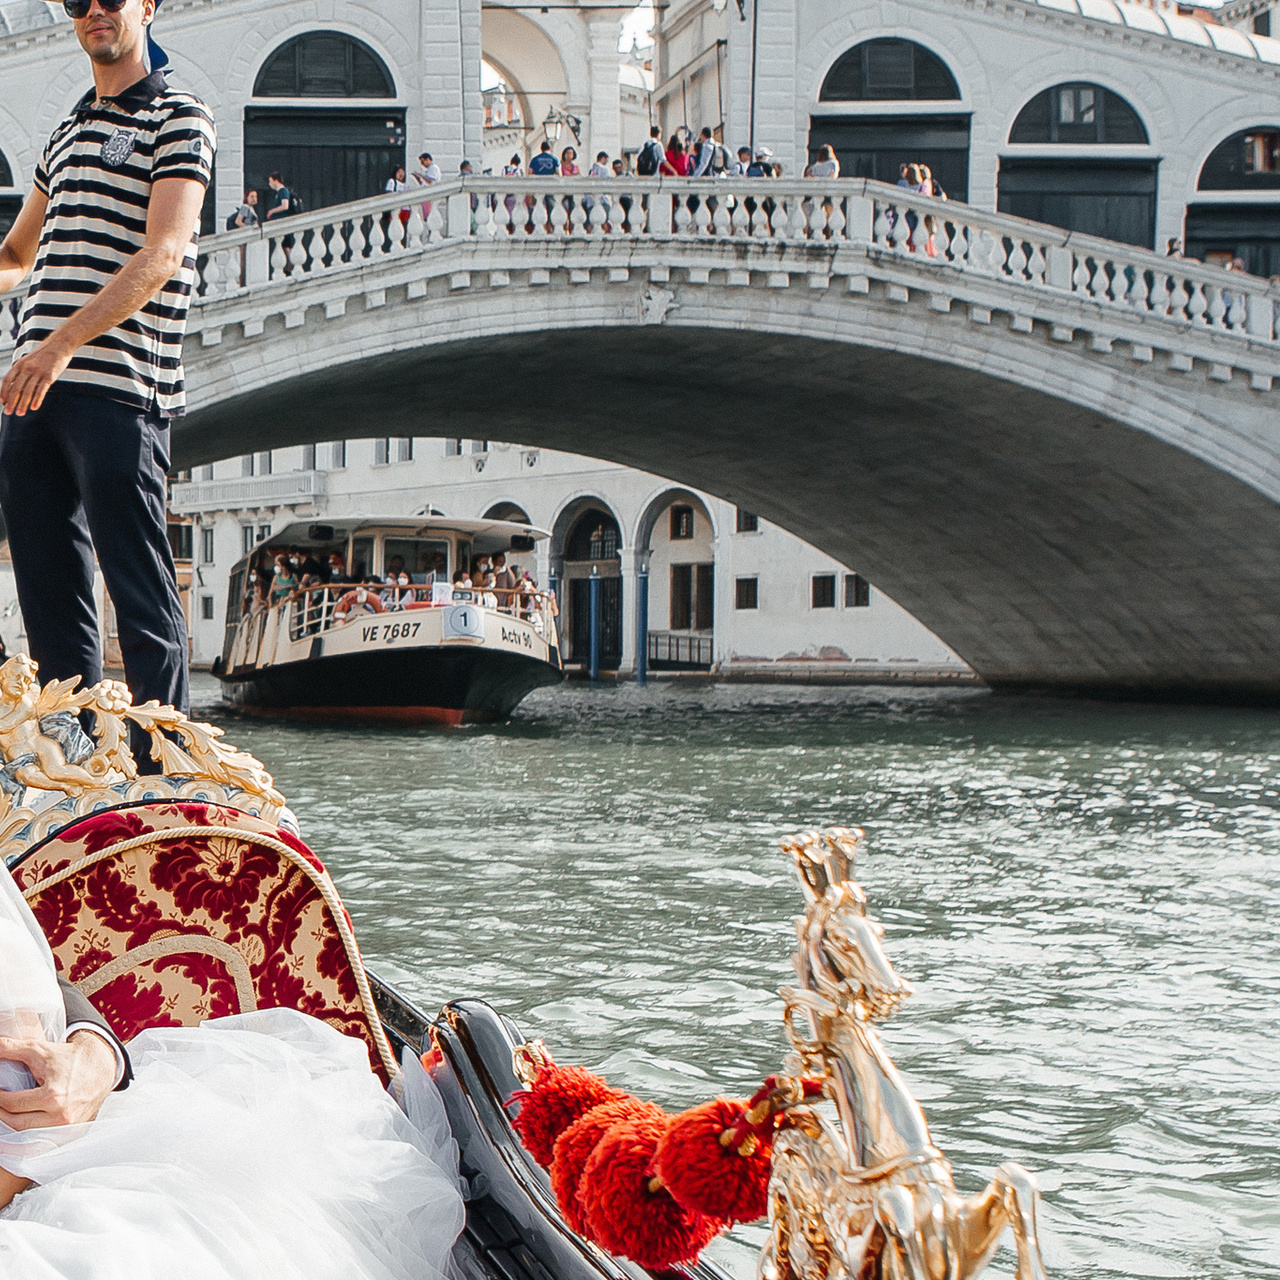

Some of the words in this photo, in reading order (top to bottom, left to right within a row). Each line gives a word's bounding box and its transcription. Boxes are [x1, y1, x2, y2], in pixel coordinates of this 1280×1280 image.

[460, 612, 467, 627] 1
[362, 626, 378, 642] VE
[383, 622, 421, 639] 7687
